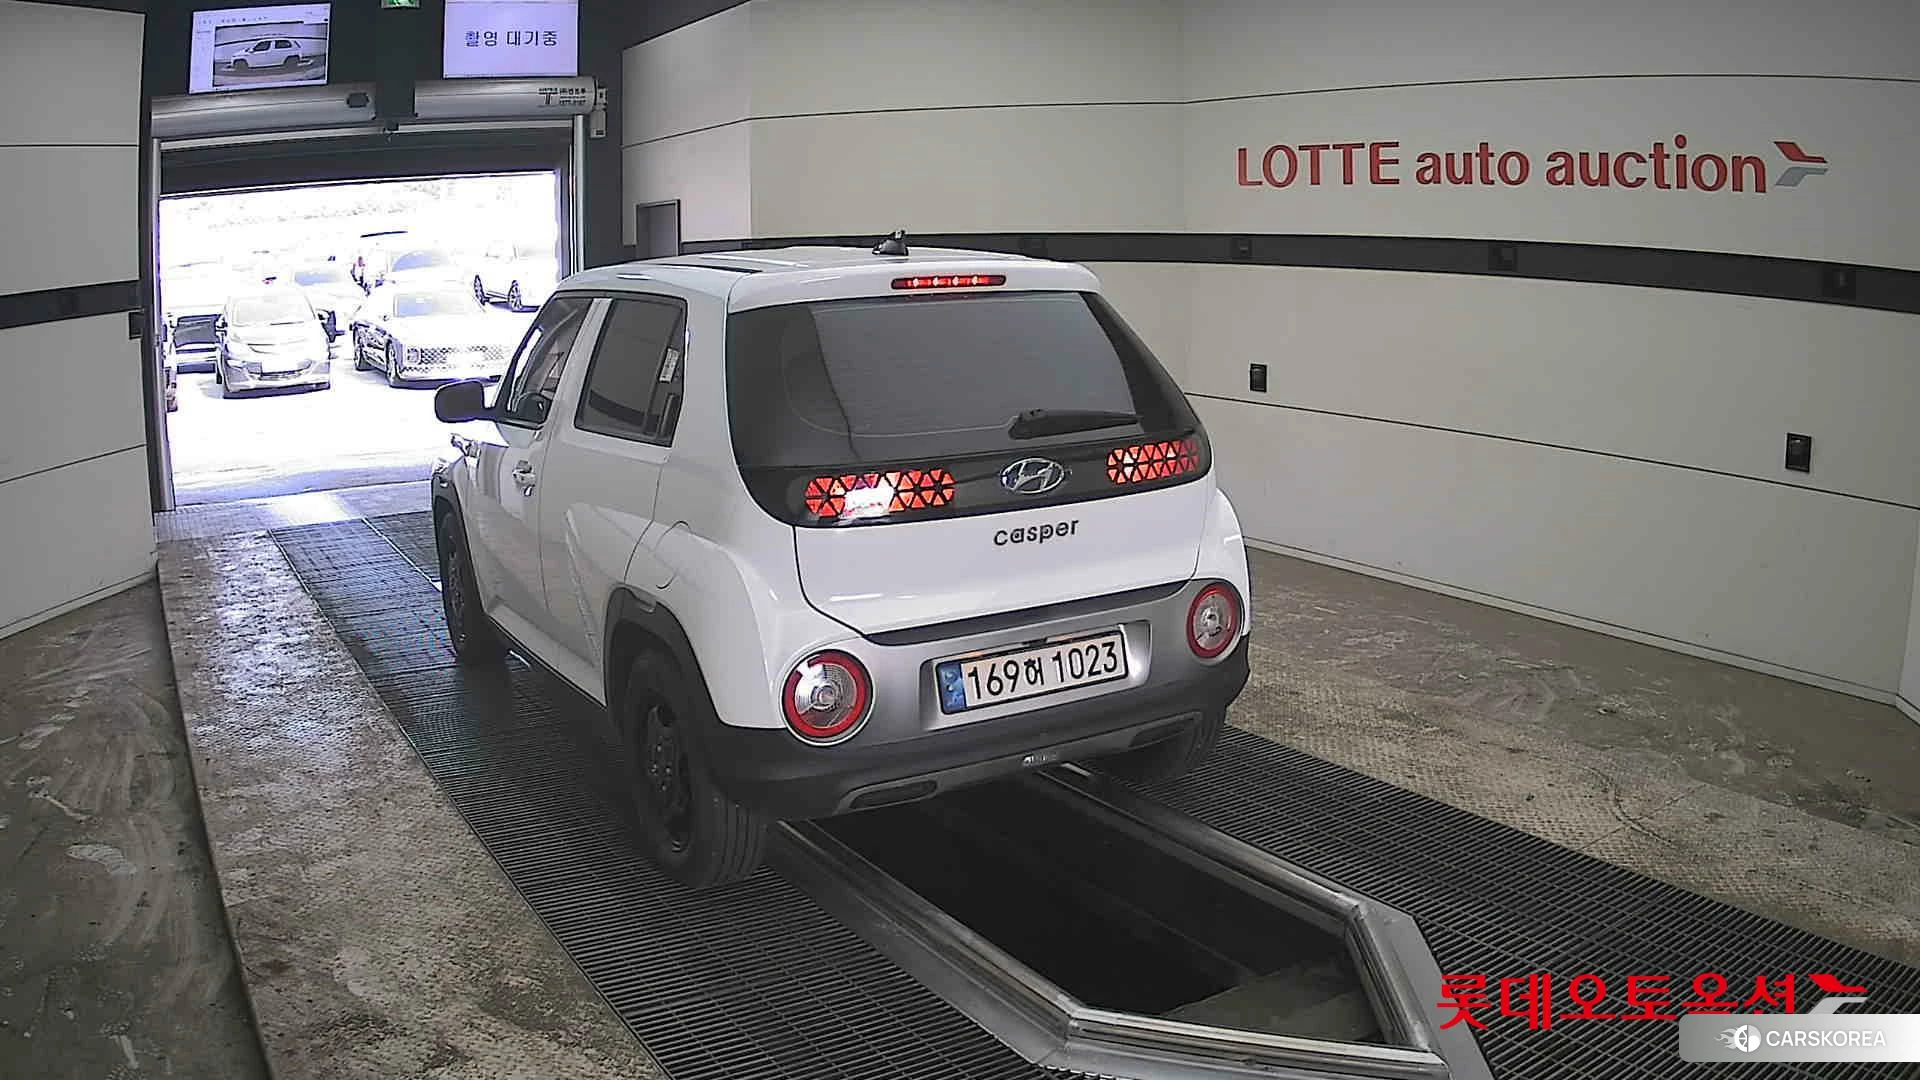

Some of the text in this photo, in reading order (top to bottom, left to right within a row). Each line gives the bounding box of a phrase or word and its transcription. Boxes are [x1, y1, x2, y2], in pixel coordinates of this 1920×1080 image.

[465, 30, 557, 47] 촬영 대기중
[1237, 134, 1767, 194] LOTTE auto auction
[993, 519, 1079, 546] casper
[967, 641, 1118, 700] 169허 1023
